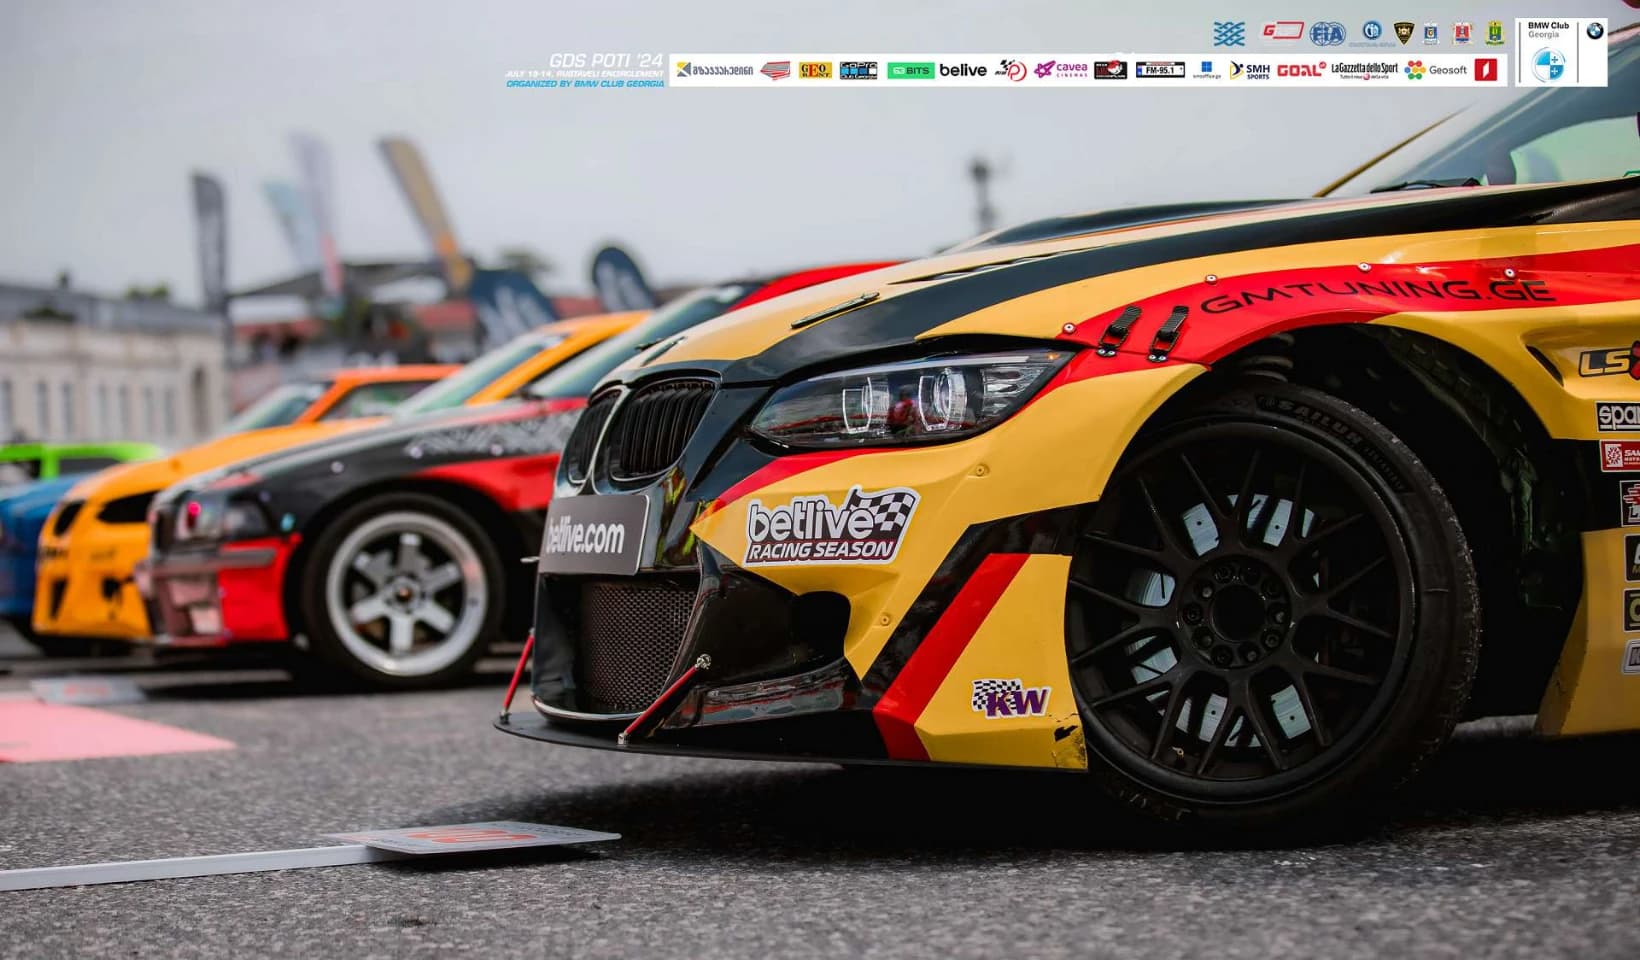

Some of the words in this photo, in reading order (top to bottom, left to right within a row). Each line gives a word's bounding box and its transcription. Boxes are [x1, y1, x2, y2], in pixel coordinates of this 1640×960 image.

[1200, 280, 1557, 314] GMTUNING.GE
[1598, 404, 1640, 431] spa
[749, 500, 874, 543] betlive
[749, 542, 813, 560] RACING
[813, 541, 894, 558] SEASON
[985, 689, 1048, 717] KW
